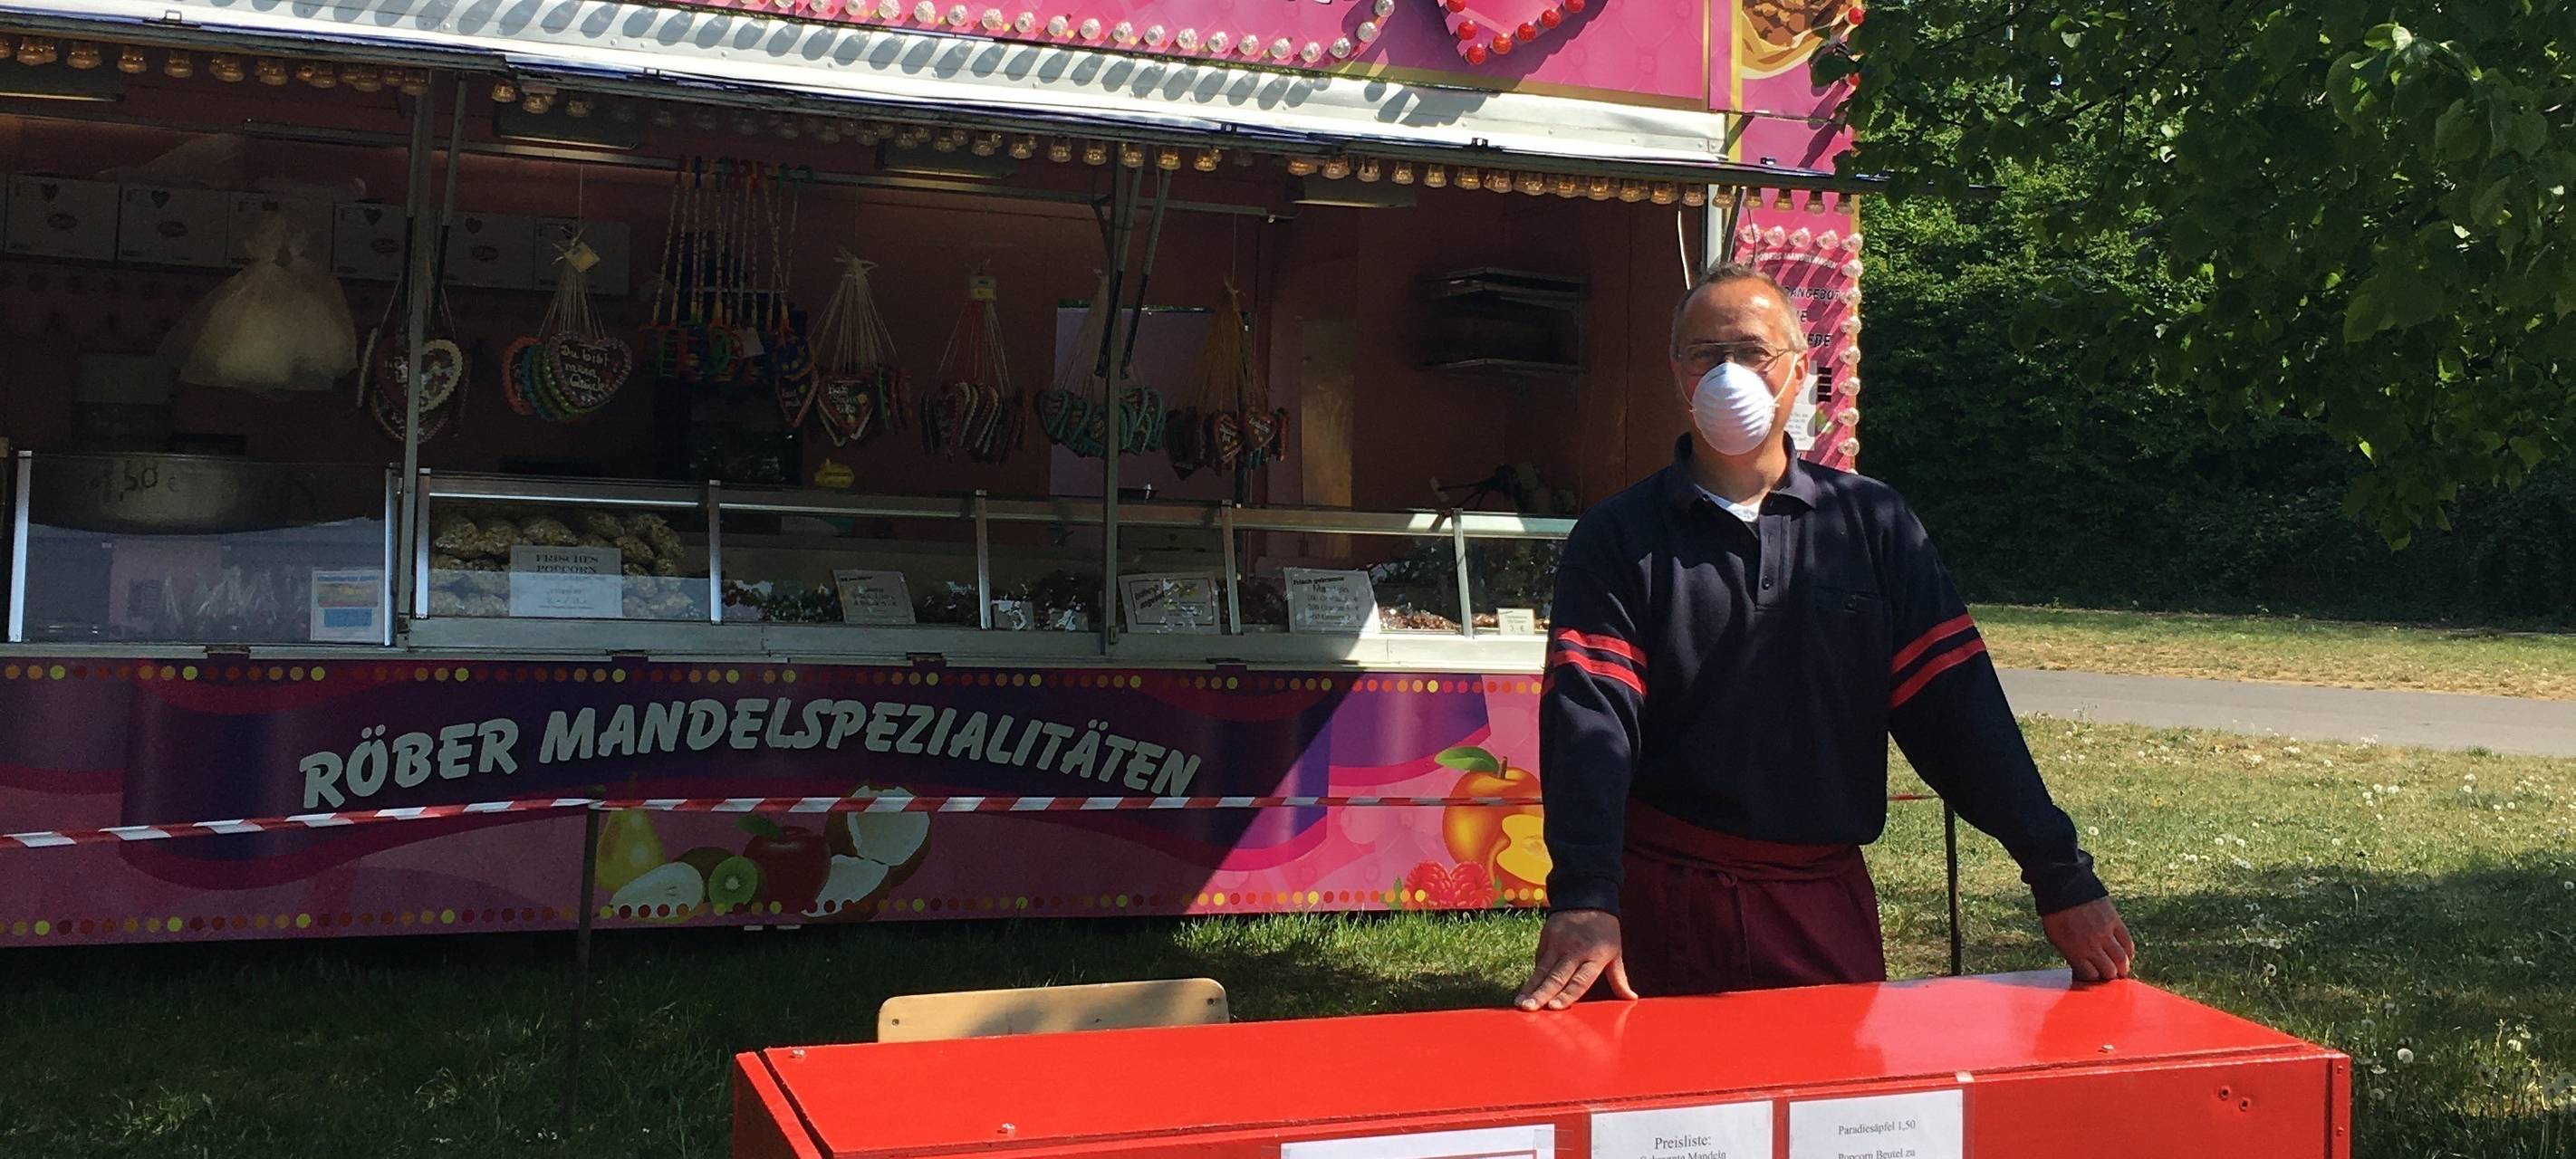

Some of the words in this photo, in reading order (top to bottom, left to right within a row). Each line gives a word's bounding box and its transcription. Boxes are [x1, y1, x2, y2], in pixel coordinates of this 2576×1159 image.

[536, 564, 597, 574] POPCORN
[300, 717, 520, 809] RÖBER
[538, 697, 1202, 798] MANDELSPEZIALITÄTEN
[1838, 1121, 1895, 1135] Paradiesäpfel
[1898, 1119, 1917, 1132] 1,50
[1654, 1134, 1712, 1149] Preisliste:
[1876, 1147, 1904, 1159] Beutel
[1905, 1149, 1917, 1158] zu
